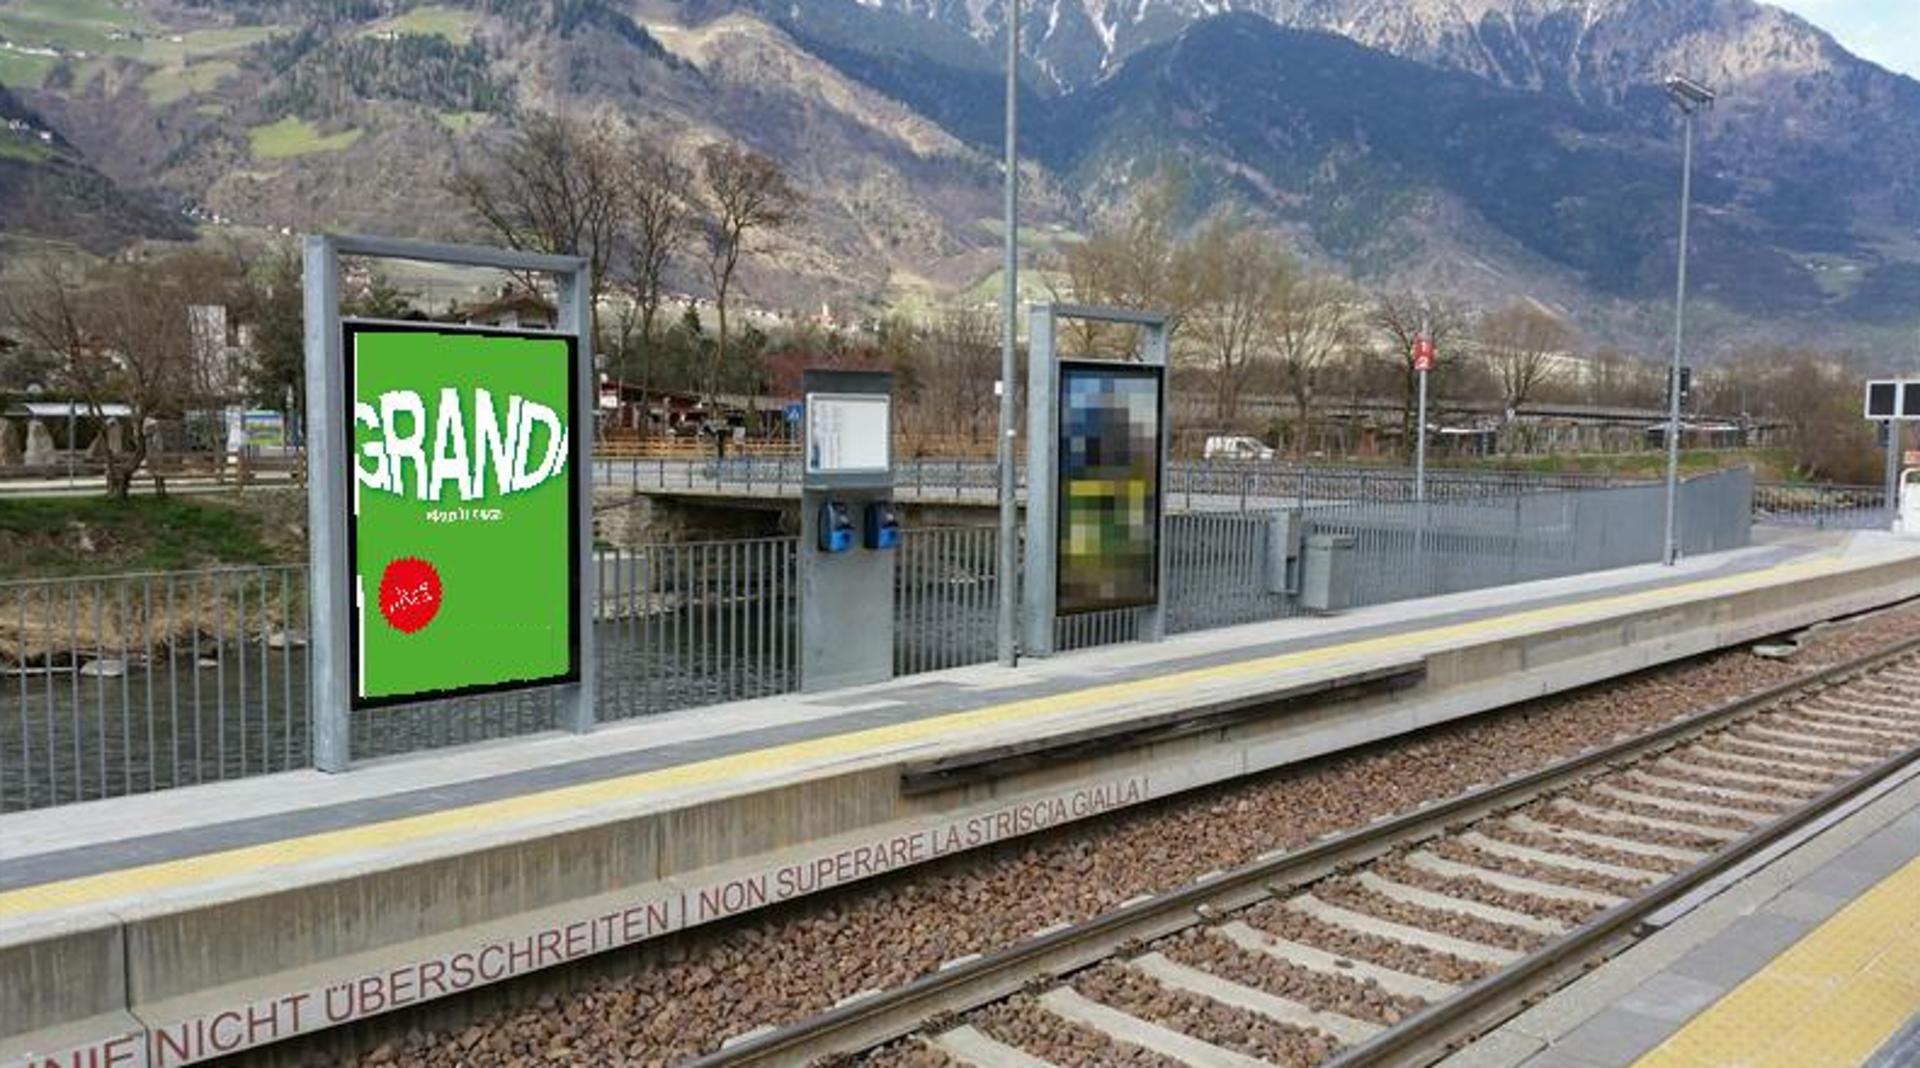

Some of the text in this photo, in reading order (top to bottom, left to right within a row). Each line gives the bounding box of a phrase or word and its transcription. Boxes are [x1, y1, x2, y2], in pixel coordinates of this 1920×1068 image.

[154, 993, 310, 1067] NICHT
[324, 899, 669, 1022] ÜBERSCHREITEN
[700, 875, 767, 921] NON
[775, 831, 924, 899] SUPERARE
[931, 823, 962, 855] LA
[965, 796, 1068, 846] STRISCIA
[1072, 778, 1140, 817] GIALLA
